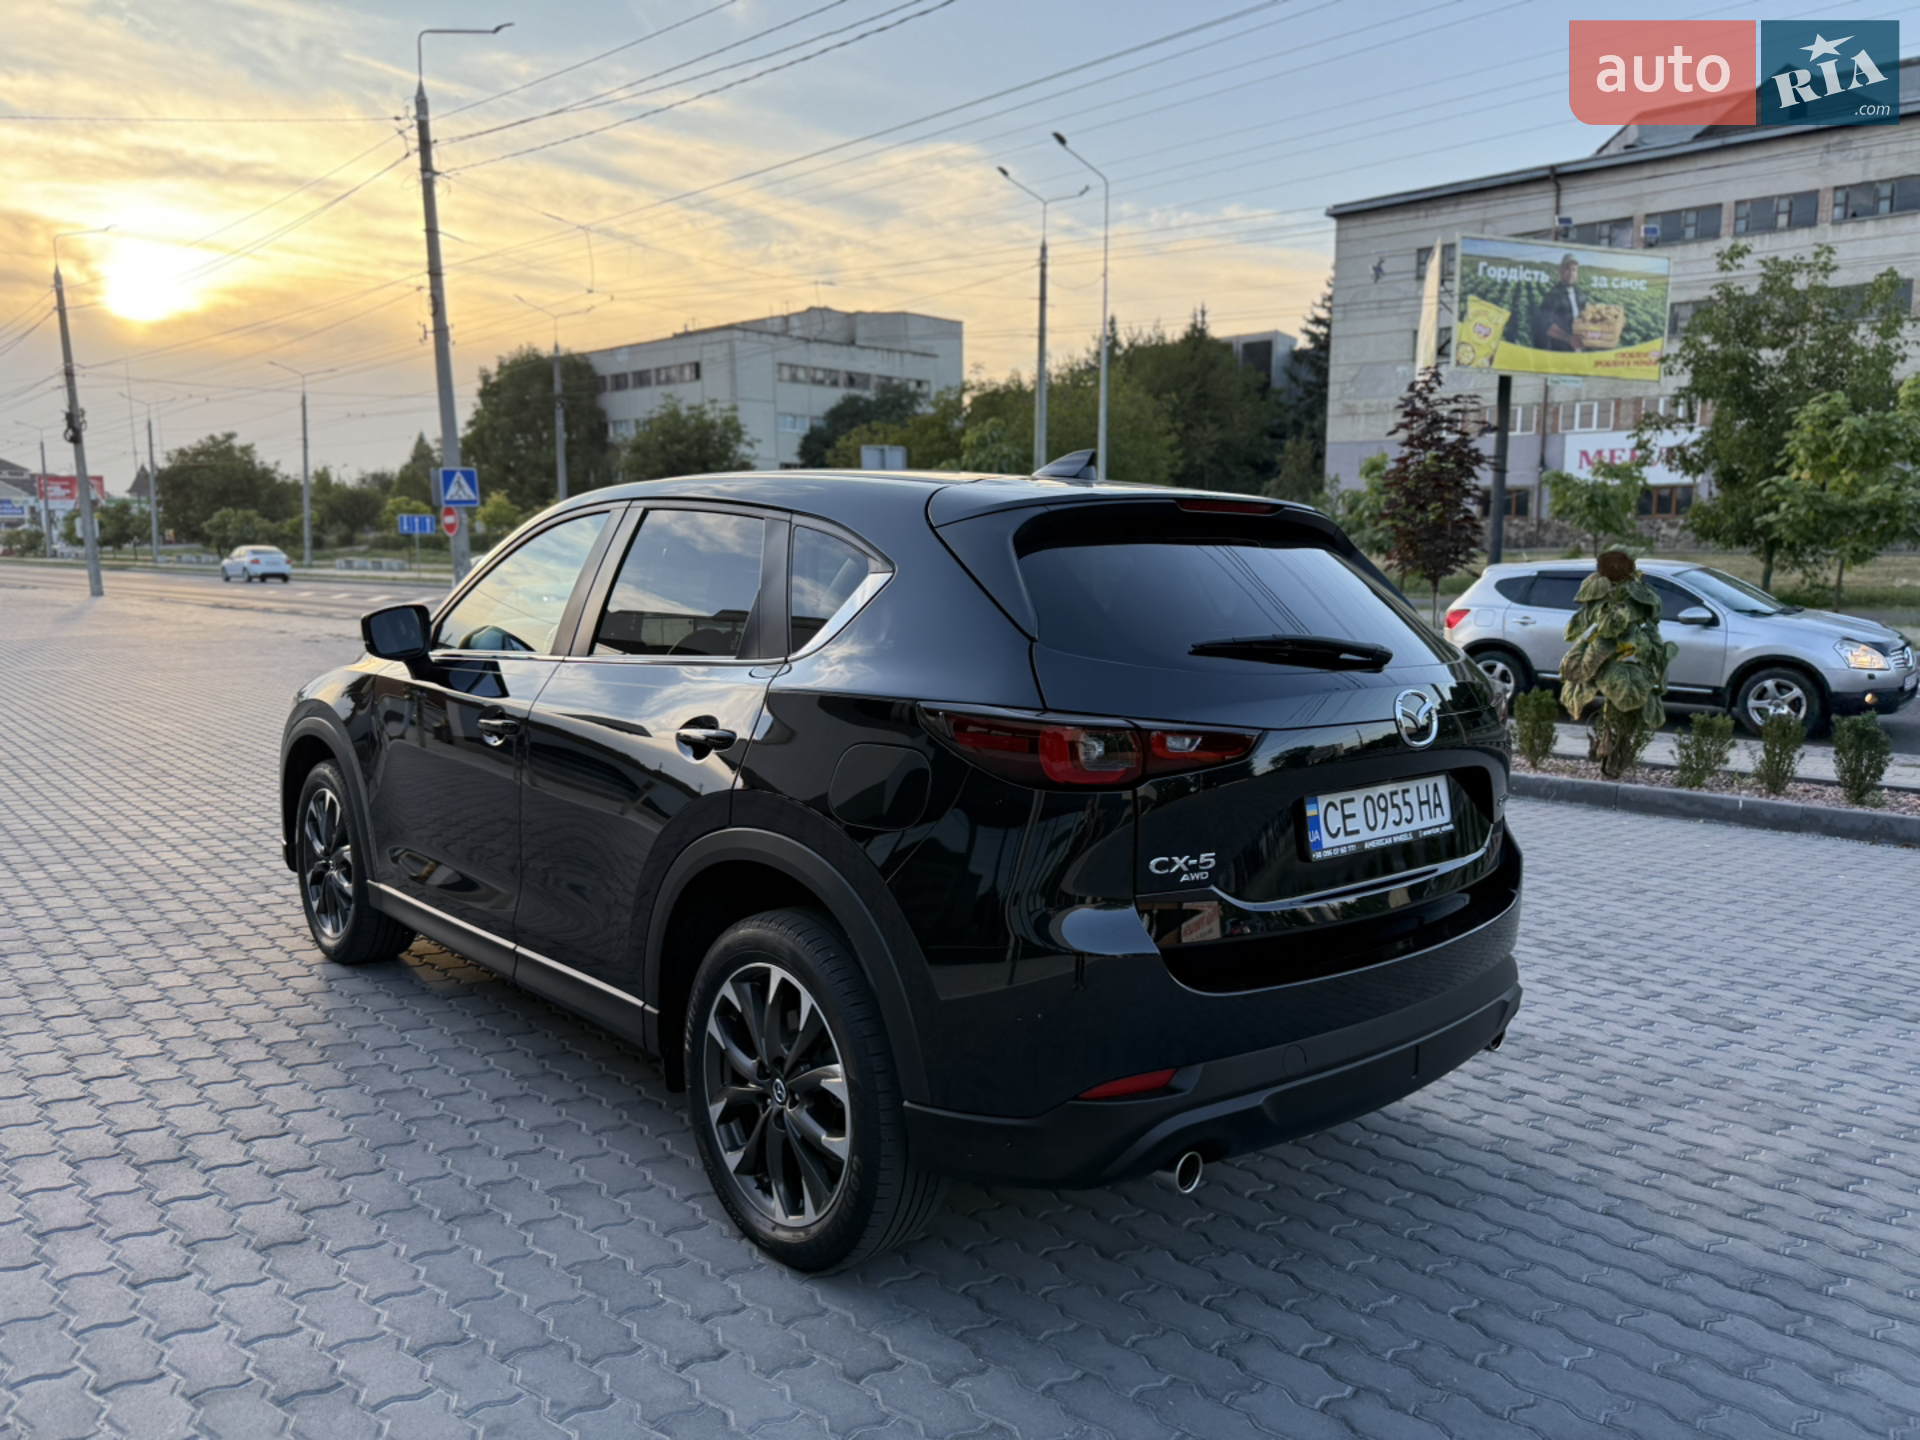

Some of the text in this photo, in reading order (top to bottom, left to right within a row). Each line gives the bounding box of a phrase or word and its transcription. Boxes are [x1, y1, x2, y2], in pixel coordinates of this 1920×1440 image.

[1478, 261, 1648, 291] Гордість за своє
[1323, 782, 1446, 839] CE 0955 HA
[1308, 829, 1321, 843] UA
[1365, 837, 1392, 849] AMERICAN
[1148, 852, 1217, 875] CX-5
[1179, 871, 1210, 883] AWD
